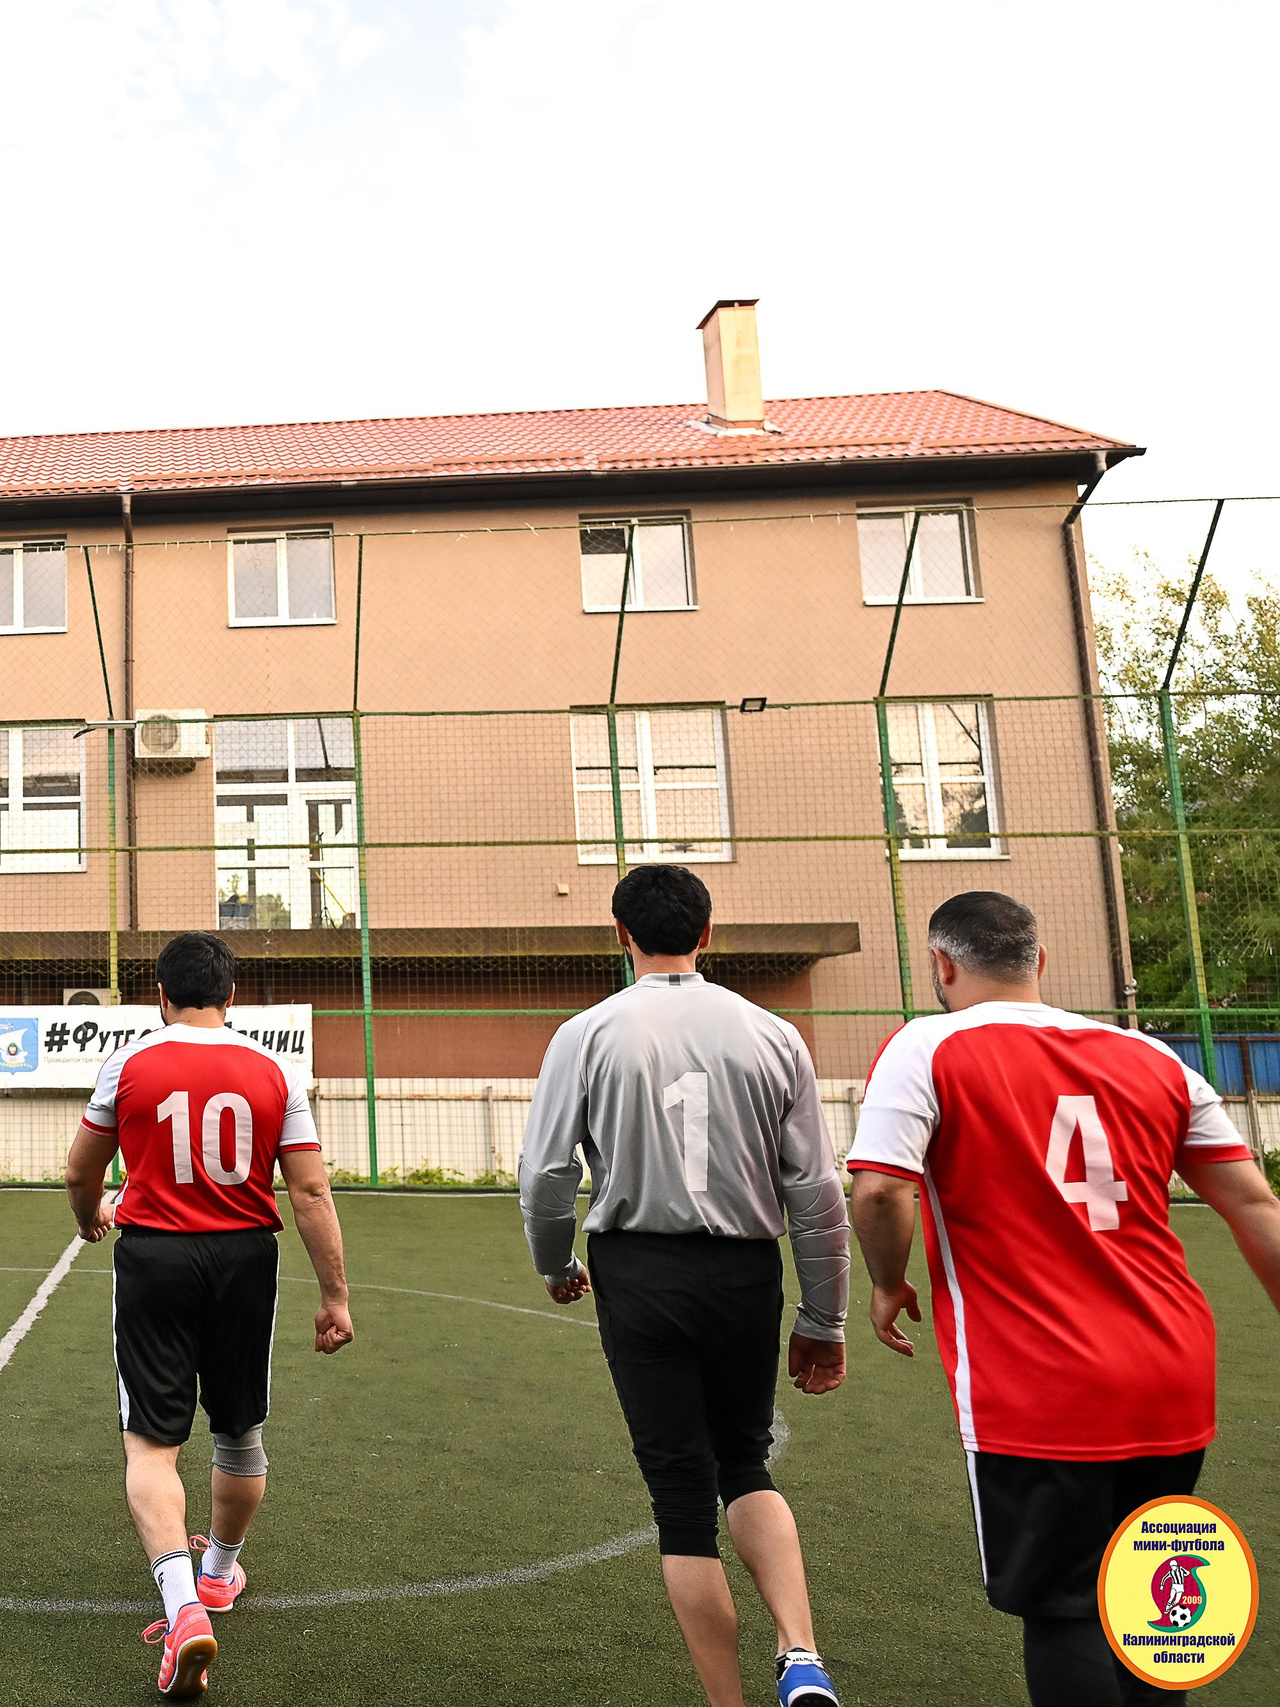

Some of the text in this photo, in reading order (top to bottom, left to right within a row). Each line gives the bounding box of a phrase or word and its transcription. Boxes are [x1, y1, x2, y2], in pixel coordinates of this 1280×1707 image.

[157, 1091, 253, 1186] 10
[663, 1071, 709, 1192] 1
[1045, 1095, 1128, 1232] 4
